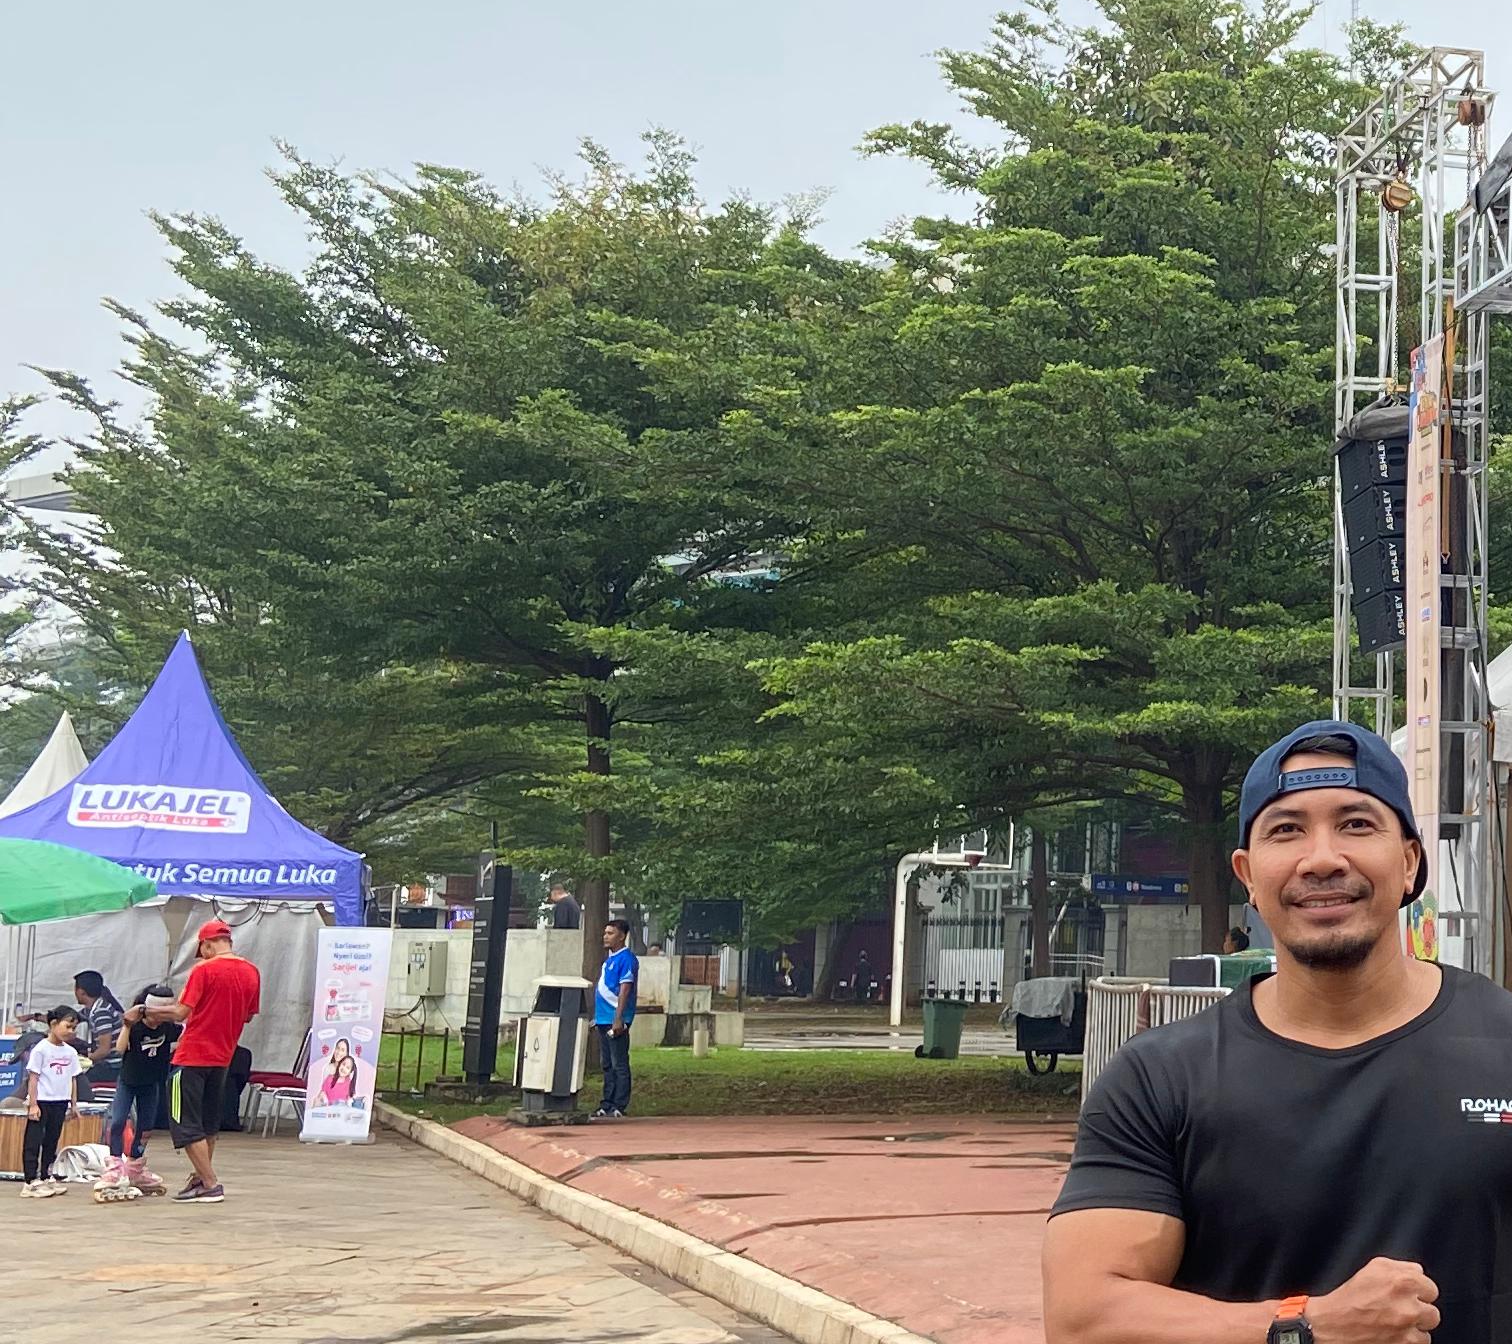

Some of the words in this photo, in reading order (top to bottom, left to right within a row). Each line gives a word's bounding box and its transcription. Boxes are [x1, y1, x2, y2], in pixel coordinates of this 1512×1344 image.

[1377, 439, 1389, 478] ASHLEY
[1382, 490, 1394, 531] ASHLEY
[1388, 542, 1400, 583] ASHLEY
[1394, 595, 1406, 636] ASHLEY
[79, 790, 237, 816] LUKAJEL
[88, 811, 169, 824] Antiseptik
[172, 816, 209, 827] Luka
[126, 862, 179, 883] tuk
[181, 862, 271, 884] Semua
[275, 863, 337, 885] Luka
